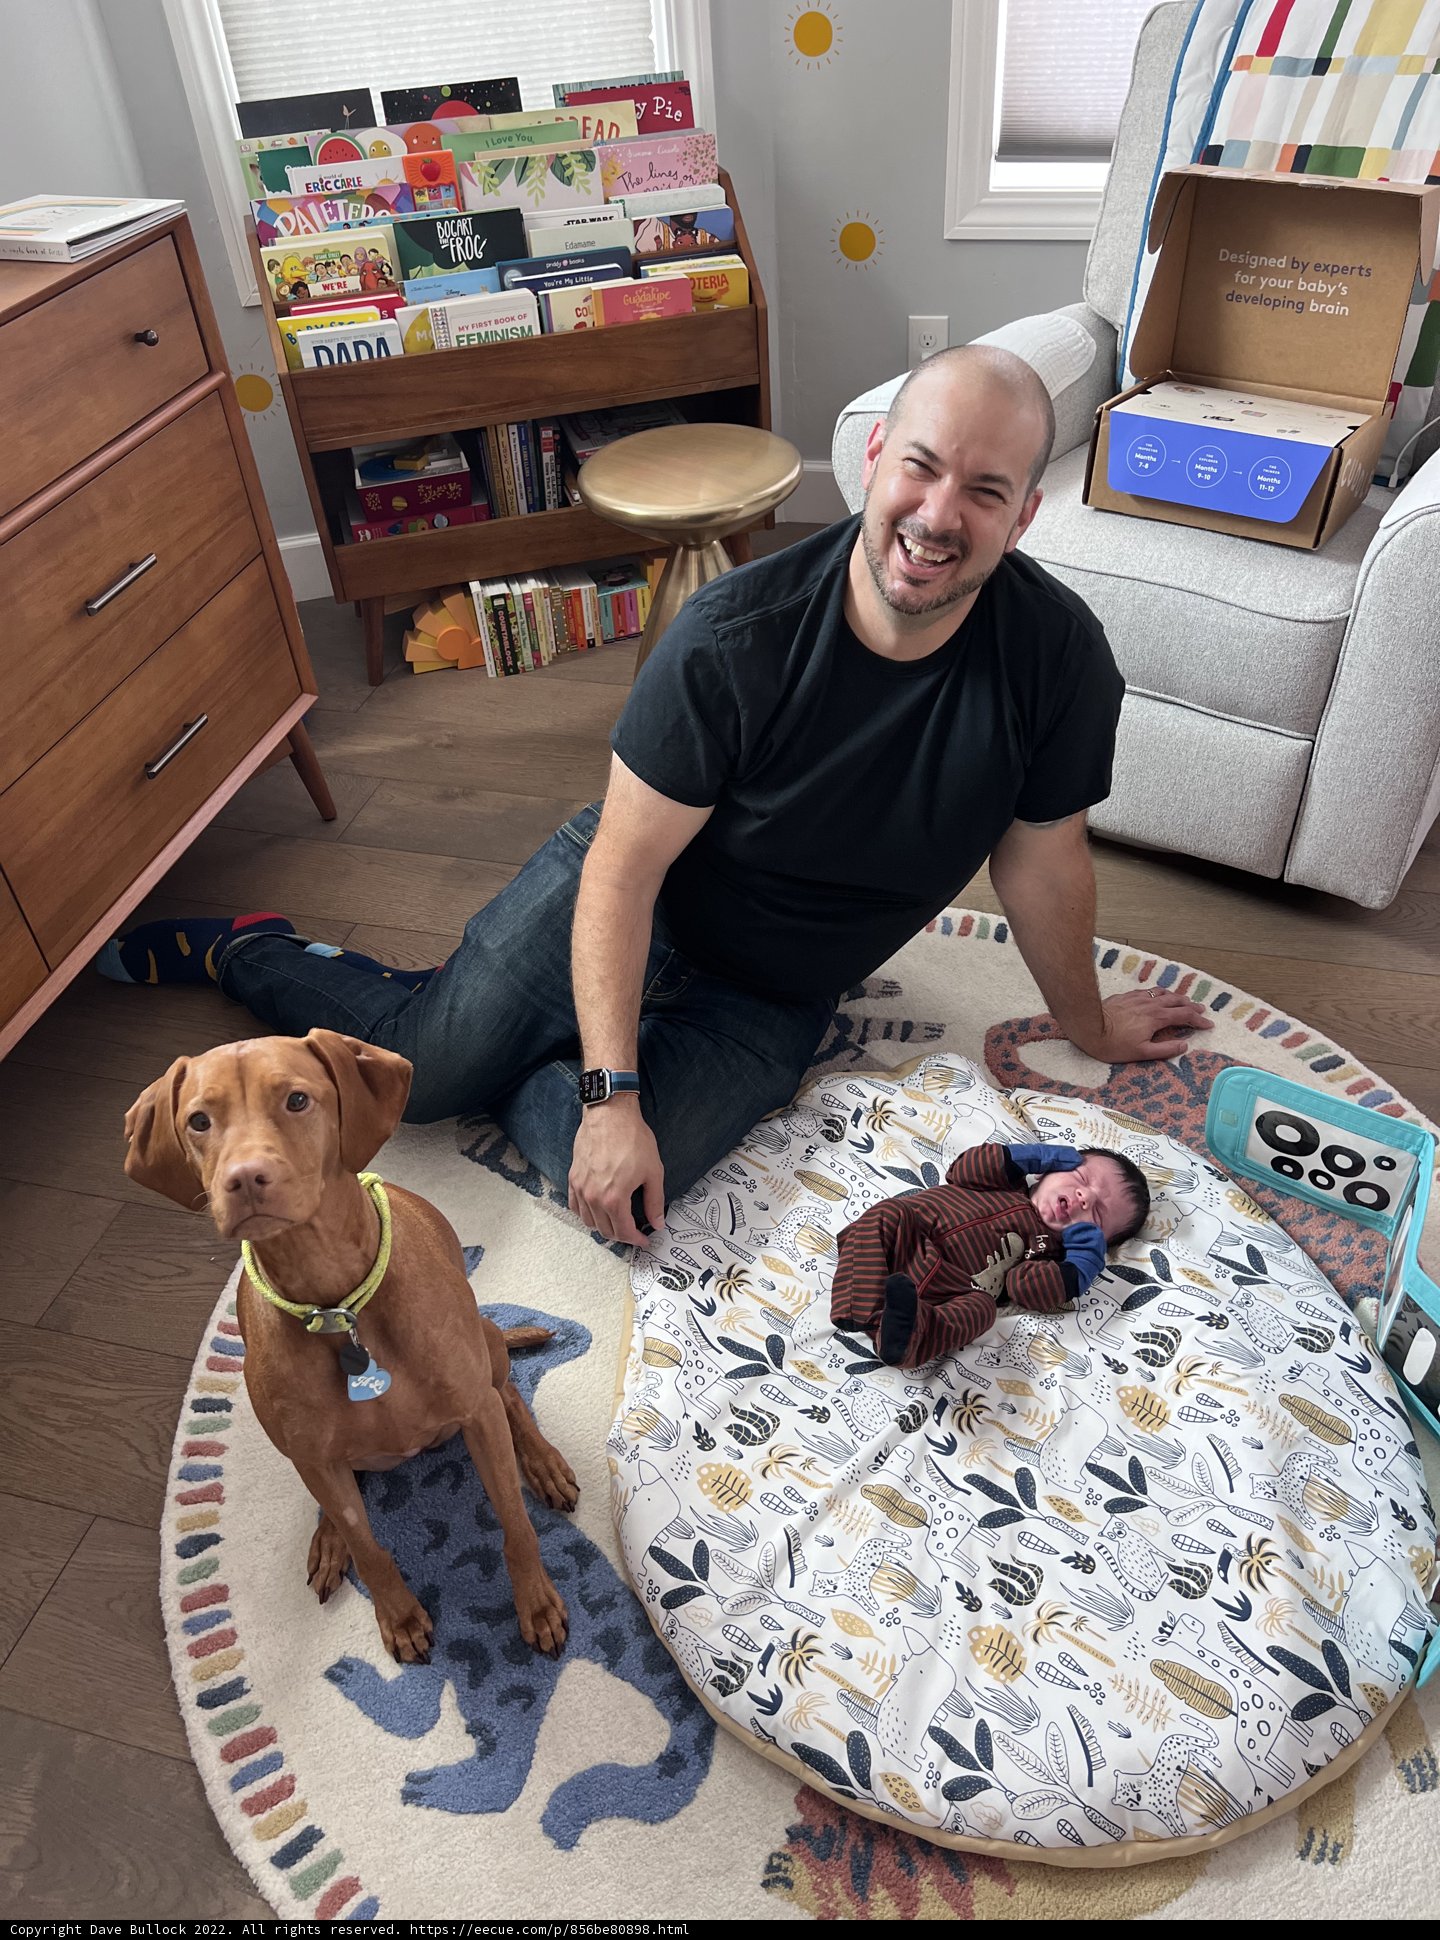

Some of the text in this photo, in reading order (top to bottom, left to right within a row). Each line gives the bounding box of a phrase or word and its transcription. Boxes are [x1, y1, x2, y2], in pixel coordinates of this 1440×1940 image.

[635, 96, 683, 121] y Pie
[491, 135, 513, 146] Love
[305, 176, 363, 193] ERIC CARLE
[617, 171, 643, 192] The
[647, 161, 678, 181] lines
[683, 174, 698, 185] on
[450, 234, 487, 263] FROG
[564, 239, 596, 250] Edamame
[546, 258, 585, 269] priddy books
[1218, 249, 1372, 278] Designed by experts
[322, 280, 348, 292] WE'RE
[544, 279, 562, 288] You're
[575, 276, 594, 284] Little
[690, 274, 729, 289] OTERIA
[1235, 271, 1349, 298] for your baby's
[623, 288, 672, 305] Guadalupe
[1225, 290, 1349, 316] developing brain
[458, 313, 528, 333] MY FIRST BOOK OF
[455, 325, 534, 347] FEMINISM
[312, 336, 391, 367] DADA
[1134, 453, 1157, 462] Months
[1194, 464, 1218, 473] Months
[1197, 473, 1211, 481] 9-10
[1257, 475, 1281, 485] Months
[1259, 484, 1275, 493] 11-12
[498, 610, 513, 667] COUNTABLOCK
